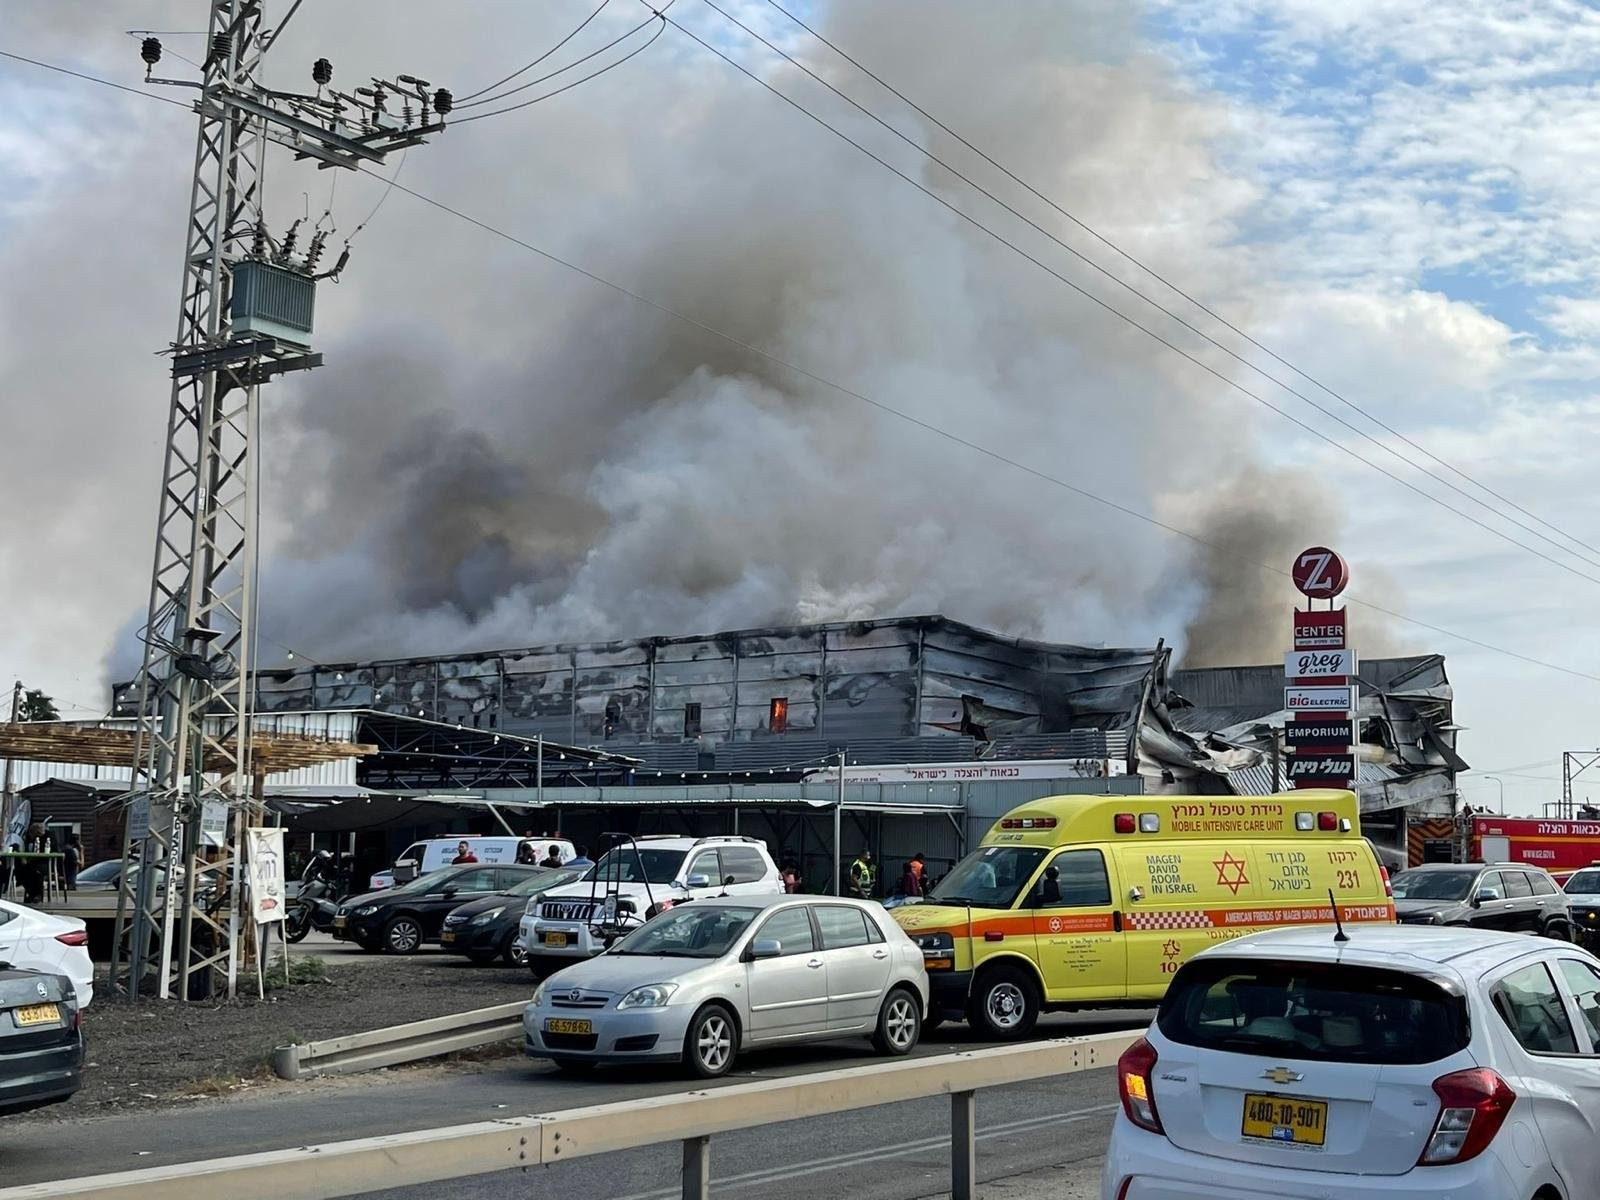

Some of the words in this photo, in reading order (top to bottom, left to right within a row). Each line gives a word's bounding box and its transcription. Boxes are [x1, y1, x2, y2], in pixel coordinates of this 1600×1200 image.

[1301, 553, 1332, 590] Z
[1295, 625, 1343, 637] CENTER
[1298, 652, 1344, 675] greg
[1288, 727, 1349, 738] EMPORIUM
[1319, 758, 1352, 774] נעלי
[1171, 805, 1205, 819] נמרץ
[1209, 802, 1245, 816] טיפול
[1251, 804, 1283, 816] ניידת
[1171, 820, 1201, 832] MOBILE
[1202, 820, 1242, 832] INTENSIVE
[1243, 820, 1264, 831] CARE
[1266, 820, 1284, 831] UNIT
[1538, 822, 1567, 835] והצלה
[1146, 854, 1181, 864] MAGEN
[1266, 852, 1285, 863] דוד
[1287, 852, 1306, 864] מגן
[1327, 851, 1358, 864] ירקון
[1148, 864, 1179, 874] DAVID
[1282, 865, 1309, 877] אדום
[1151, 874, 1181, 884] ADOM
[1268, 877, 1312, 891] בישראל
[1337, 870, 1360, 889] 231
[1152, 884, 1163, 894] IN
[1165, 883, 1198, 894] ISRAEL
[1160, 961, 1184, 973] 10
